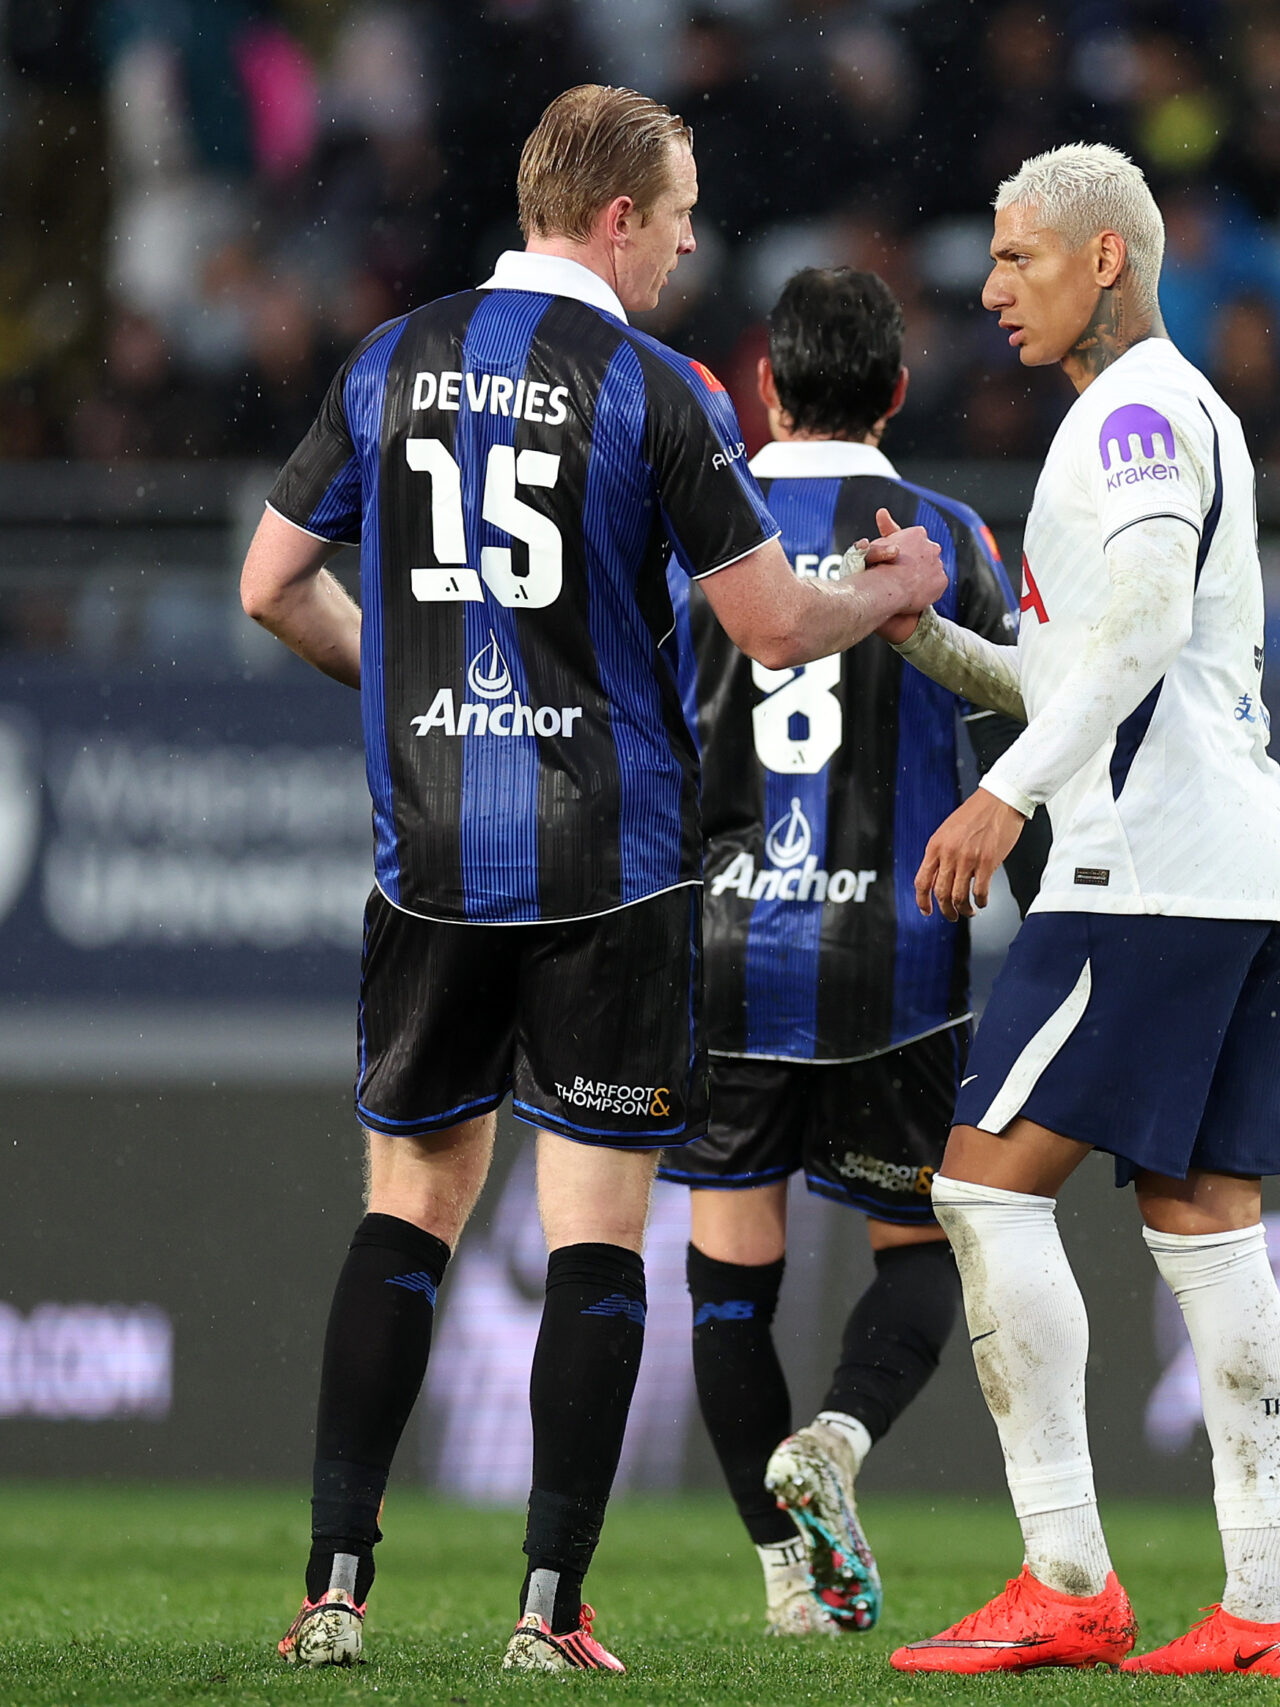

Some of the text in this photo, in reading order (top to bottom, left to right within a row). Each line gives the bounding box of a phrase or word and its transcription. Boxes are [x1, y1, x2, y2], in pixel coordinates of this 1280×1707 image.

[412, 371, 569, 426] DEVRIES
[1106, 464, 1180, 493] kraken
[406, 438, 564, 609] 15
[410, 687, 583, 738] Anchor
[710, 852, 877, 903] Anchor
[554, 1082, 650, 1117] THOMPSON
[573, 1076, 655, 1102] BARFOOT
